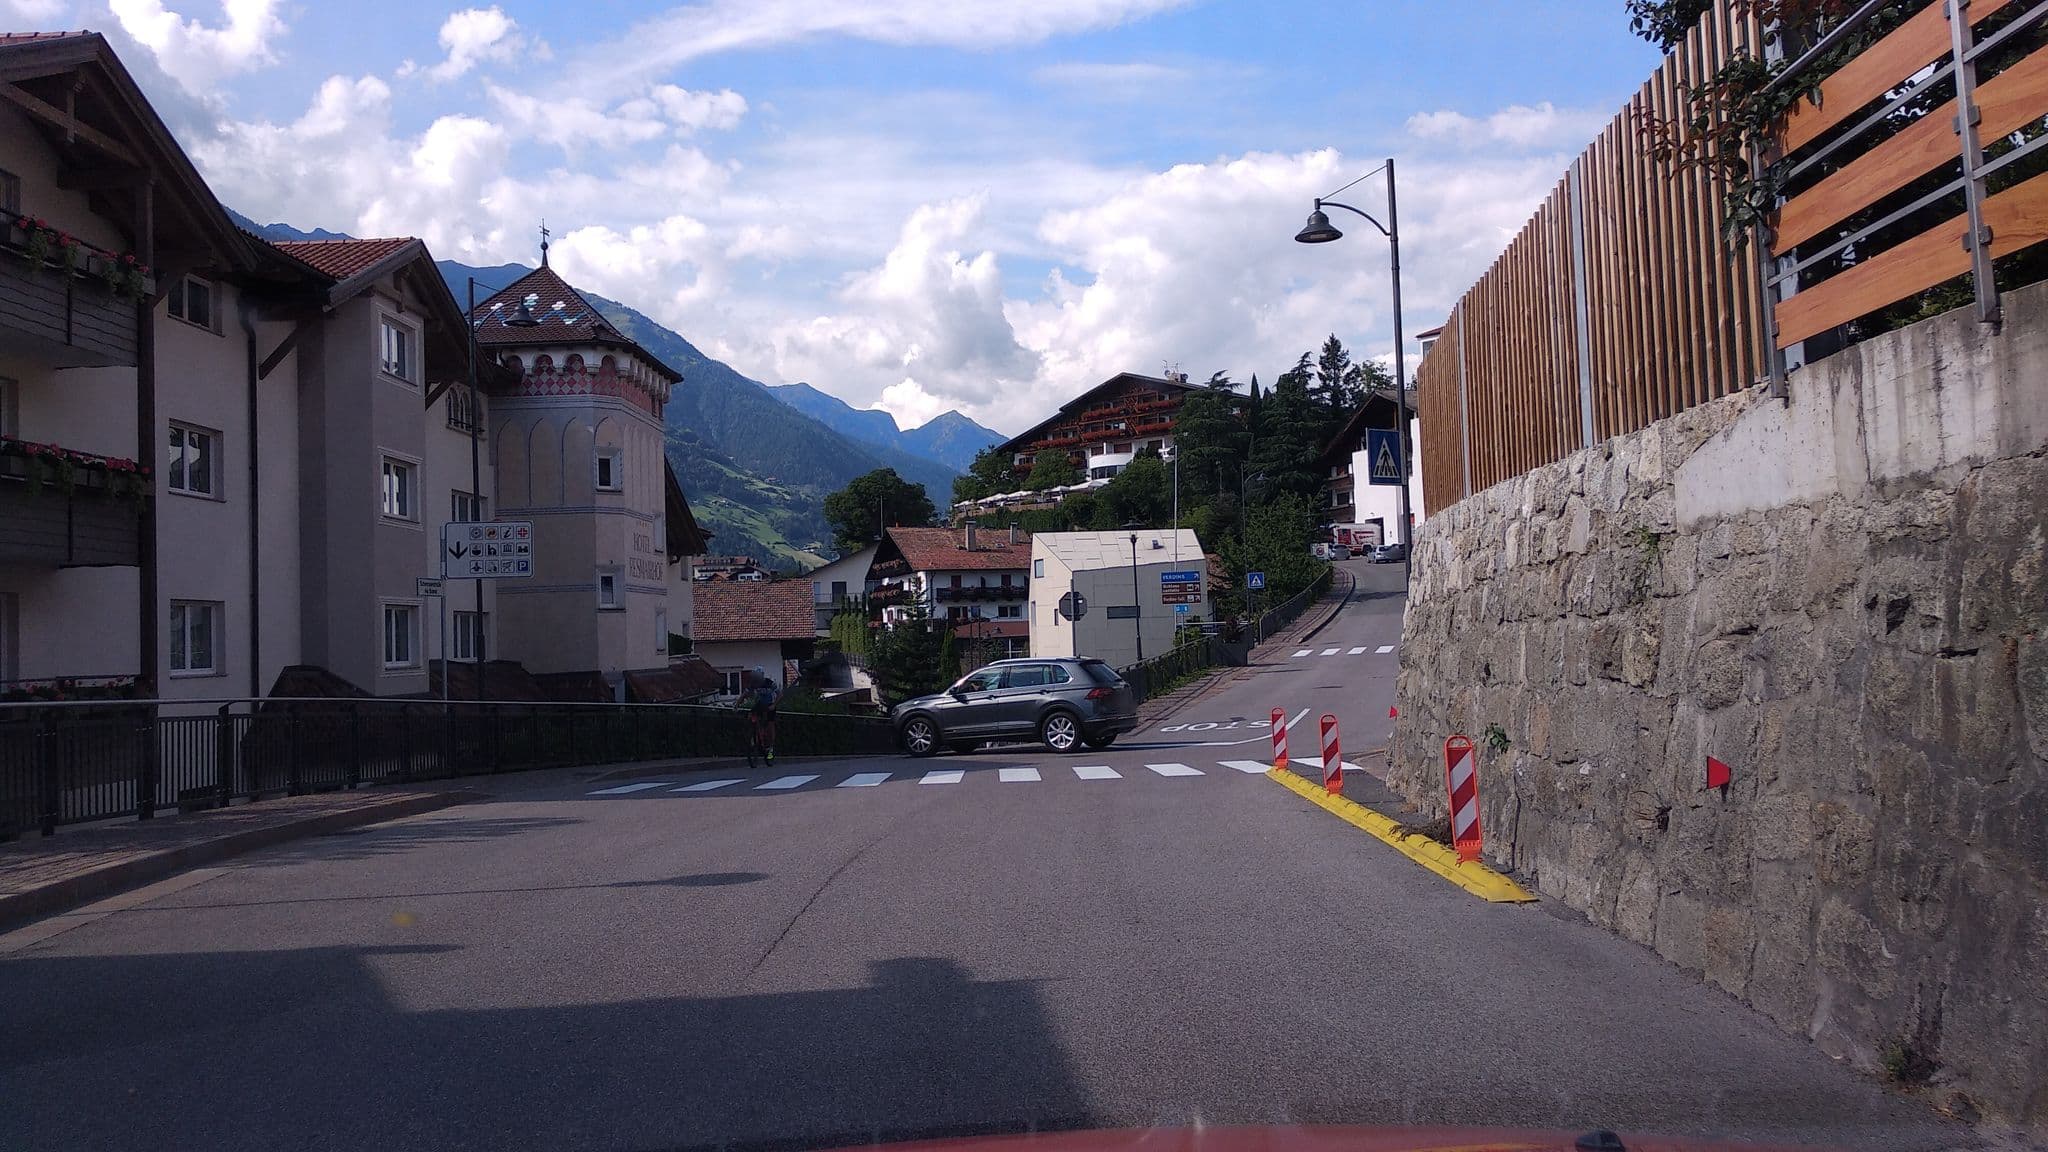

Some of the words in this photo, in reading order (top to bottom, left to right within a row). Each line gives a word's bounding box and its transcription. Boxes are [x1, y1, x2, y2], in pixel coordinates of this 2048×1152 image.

[633, 532, 650, 553] HOTEL
[519, 561, 527, 571] P
[1160, 720, 1272, 732] STOP
